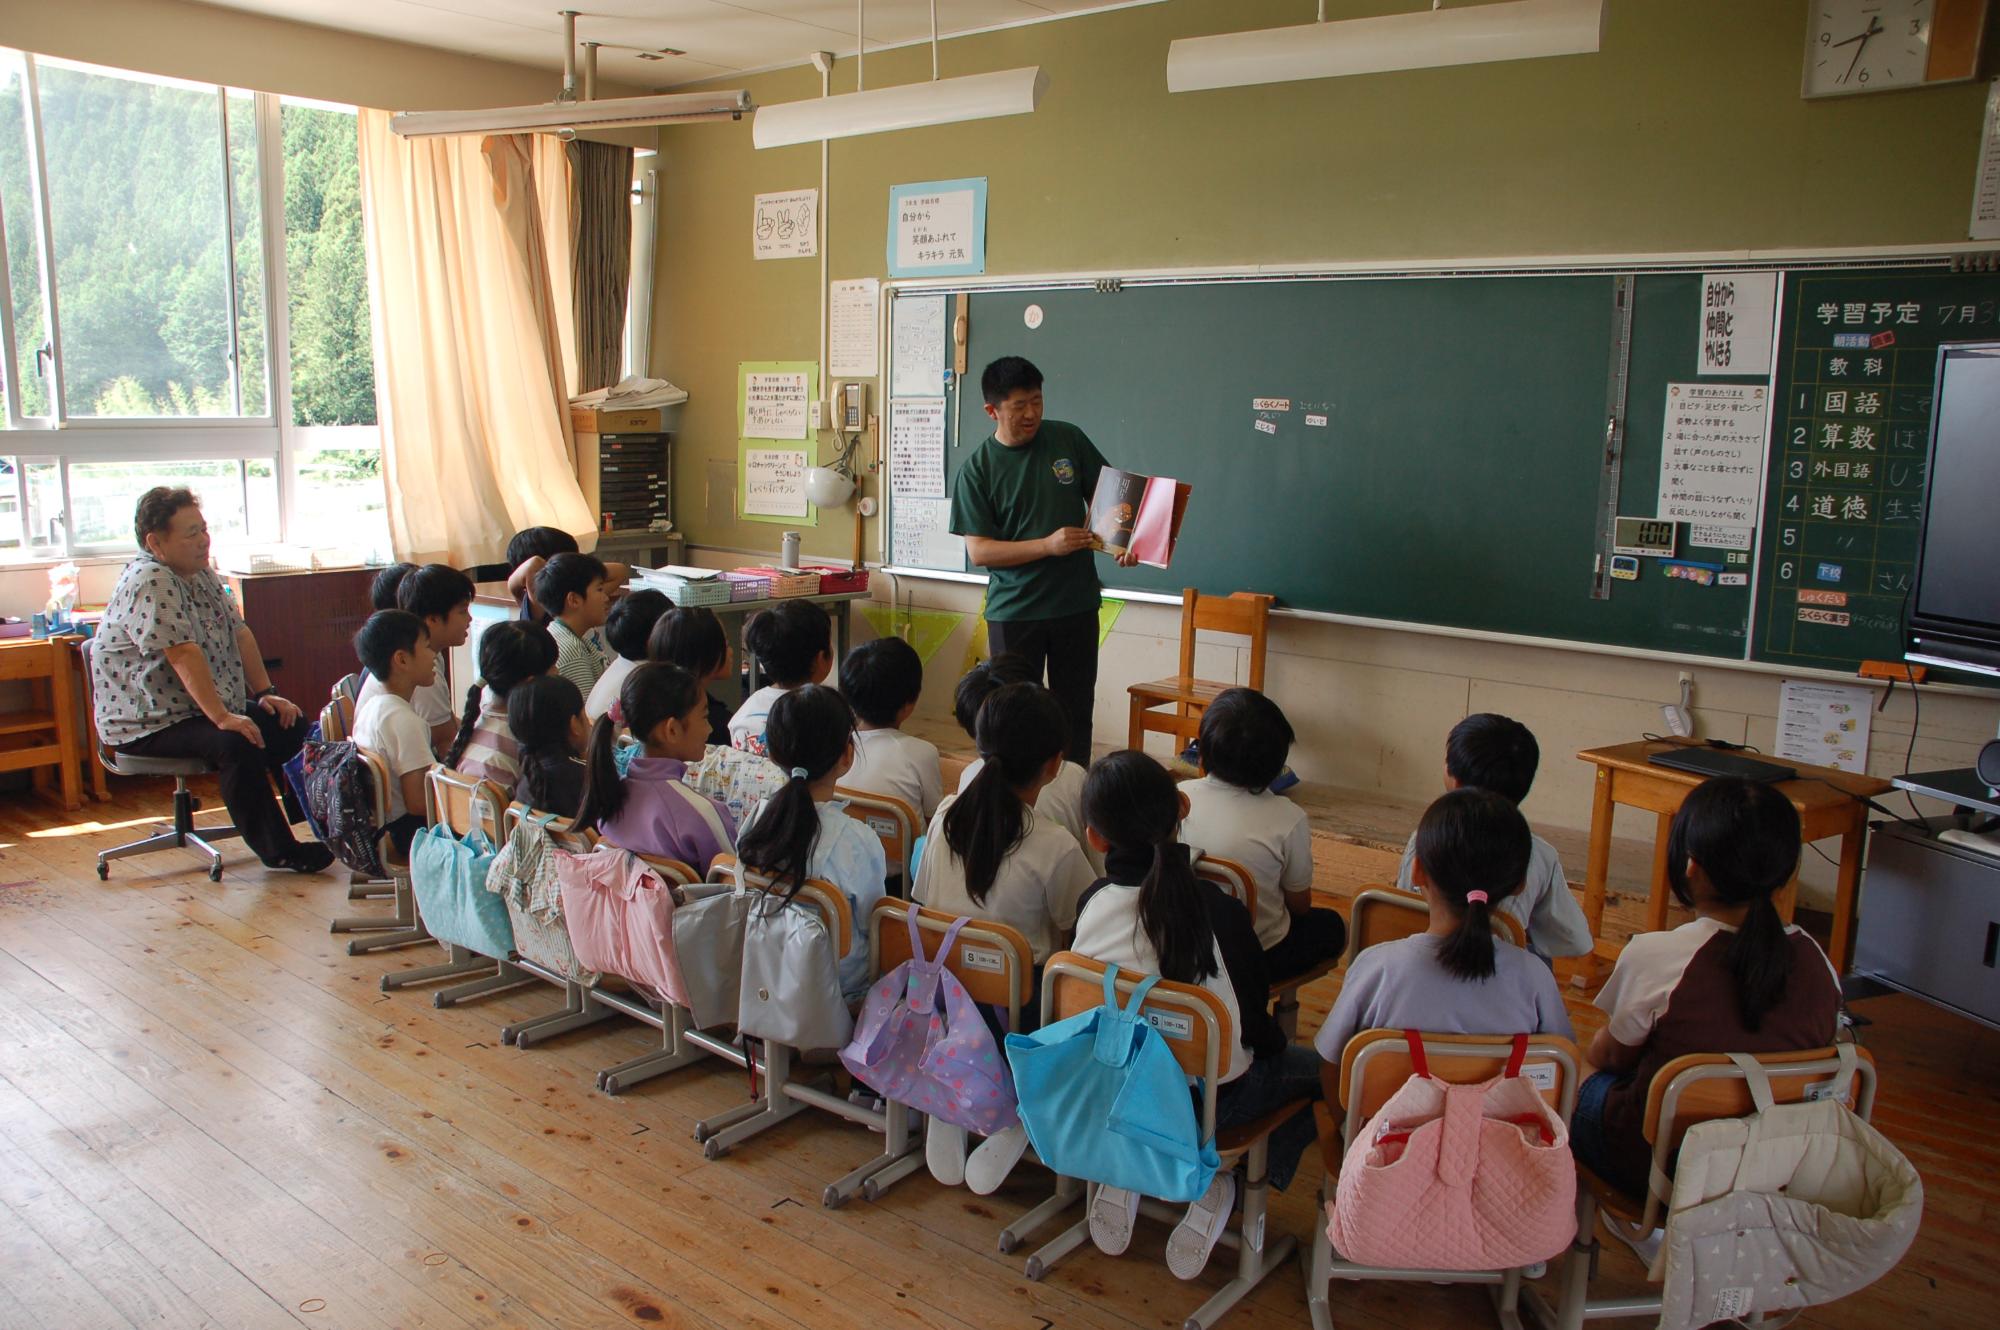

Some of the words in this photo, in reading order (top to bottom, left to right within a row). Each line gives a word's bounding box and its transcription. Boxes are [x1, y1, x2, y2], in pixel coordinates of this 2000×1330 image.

[1910, 19, 1921, 36] 3
[1820, 32, 1831, 47] 9
[1858, 67, 1870, 83] 6
[902, 211, 931, 222] 自分から
[912, 232, 957, 246] 笑顔あふれて
[918, 250, 945, 261] キラキラ
[949, 248, 965, 260] 元気
[1706, 281, 1735, 308] 自分から
[1816, 301, 1921, 326] 学習予定
[1706, 311, 1733, 338] 仲間と
[1829, 357, 1883, 377] 教科
[1689, 388, 1745, 398] 学習のあたりまえ
[1800, 393, 1805, 410] 1
[1824, 391, 1881, 415] 国語
[1676, 417, 1736, 428] 姿勢よく学習する
[1666, 432, 1672, 441] 2
[1676, 433, 1761, 444] 場に合った声の大きさで
[1793, 427, 1806, 445] 2
[1819, 423, 1876, 450] 算数
[1664, 462, 1670, 470] 3
[1673, 462, 1755, 474] 大事なことを落とさずに
[1789, 461, 1804, 479] 3
[1812, 461, 1872, 479] 外国語
[1671, 477, 1684, 486] 聞く
[1786, 494, 1800, 512] 4
[1811, 494, 1868, 520] 道徳
[1669, 507, 1747, 520] 反応したりしながら聞く
[1783, 528, 1796, 546] 5
[1727, 553, 1748, 564] 日直
[1780, 562, 1793, 580] 6
[1819, 565, 1841, 579] 下校
[1798, 590, 1846, 604] しゅくだい
[1798, 609, 1849, 625] らくらく漢字
[967, 952, 975, 962] S
[1151, 1016, 1159, 1026] S
